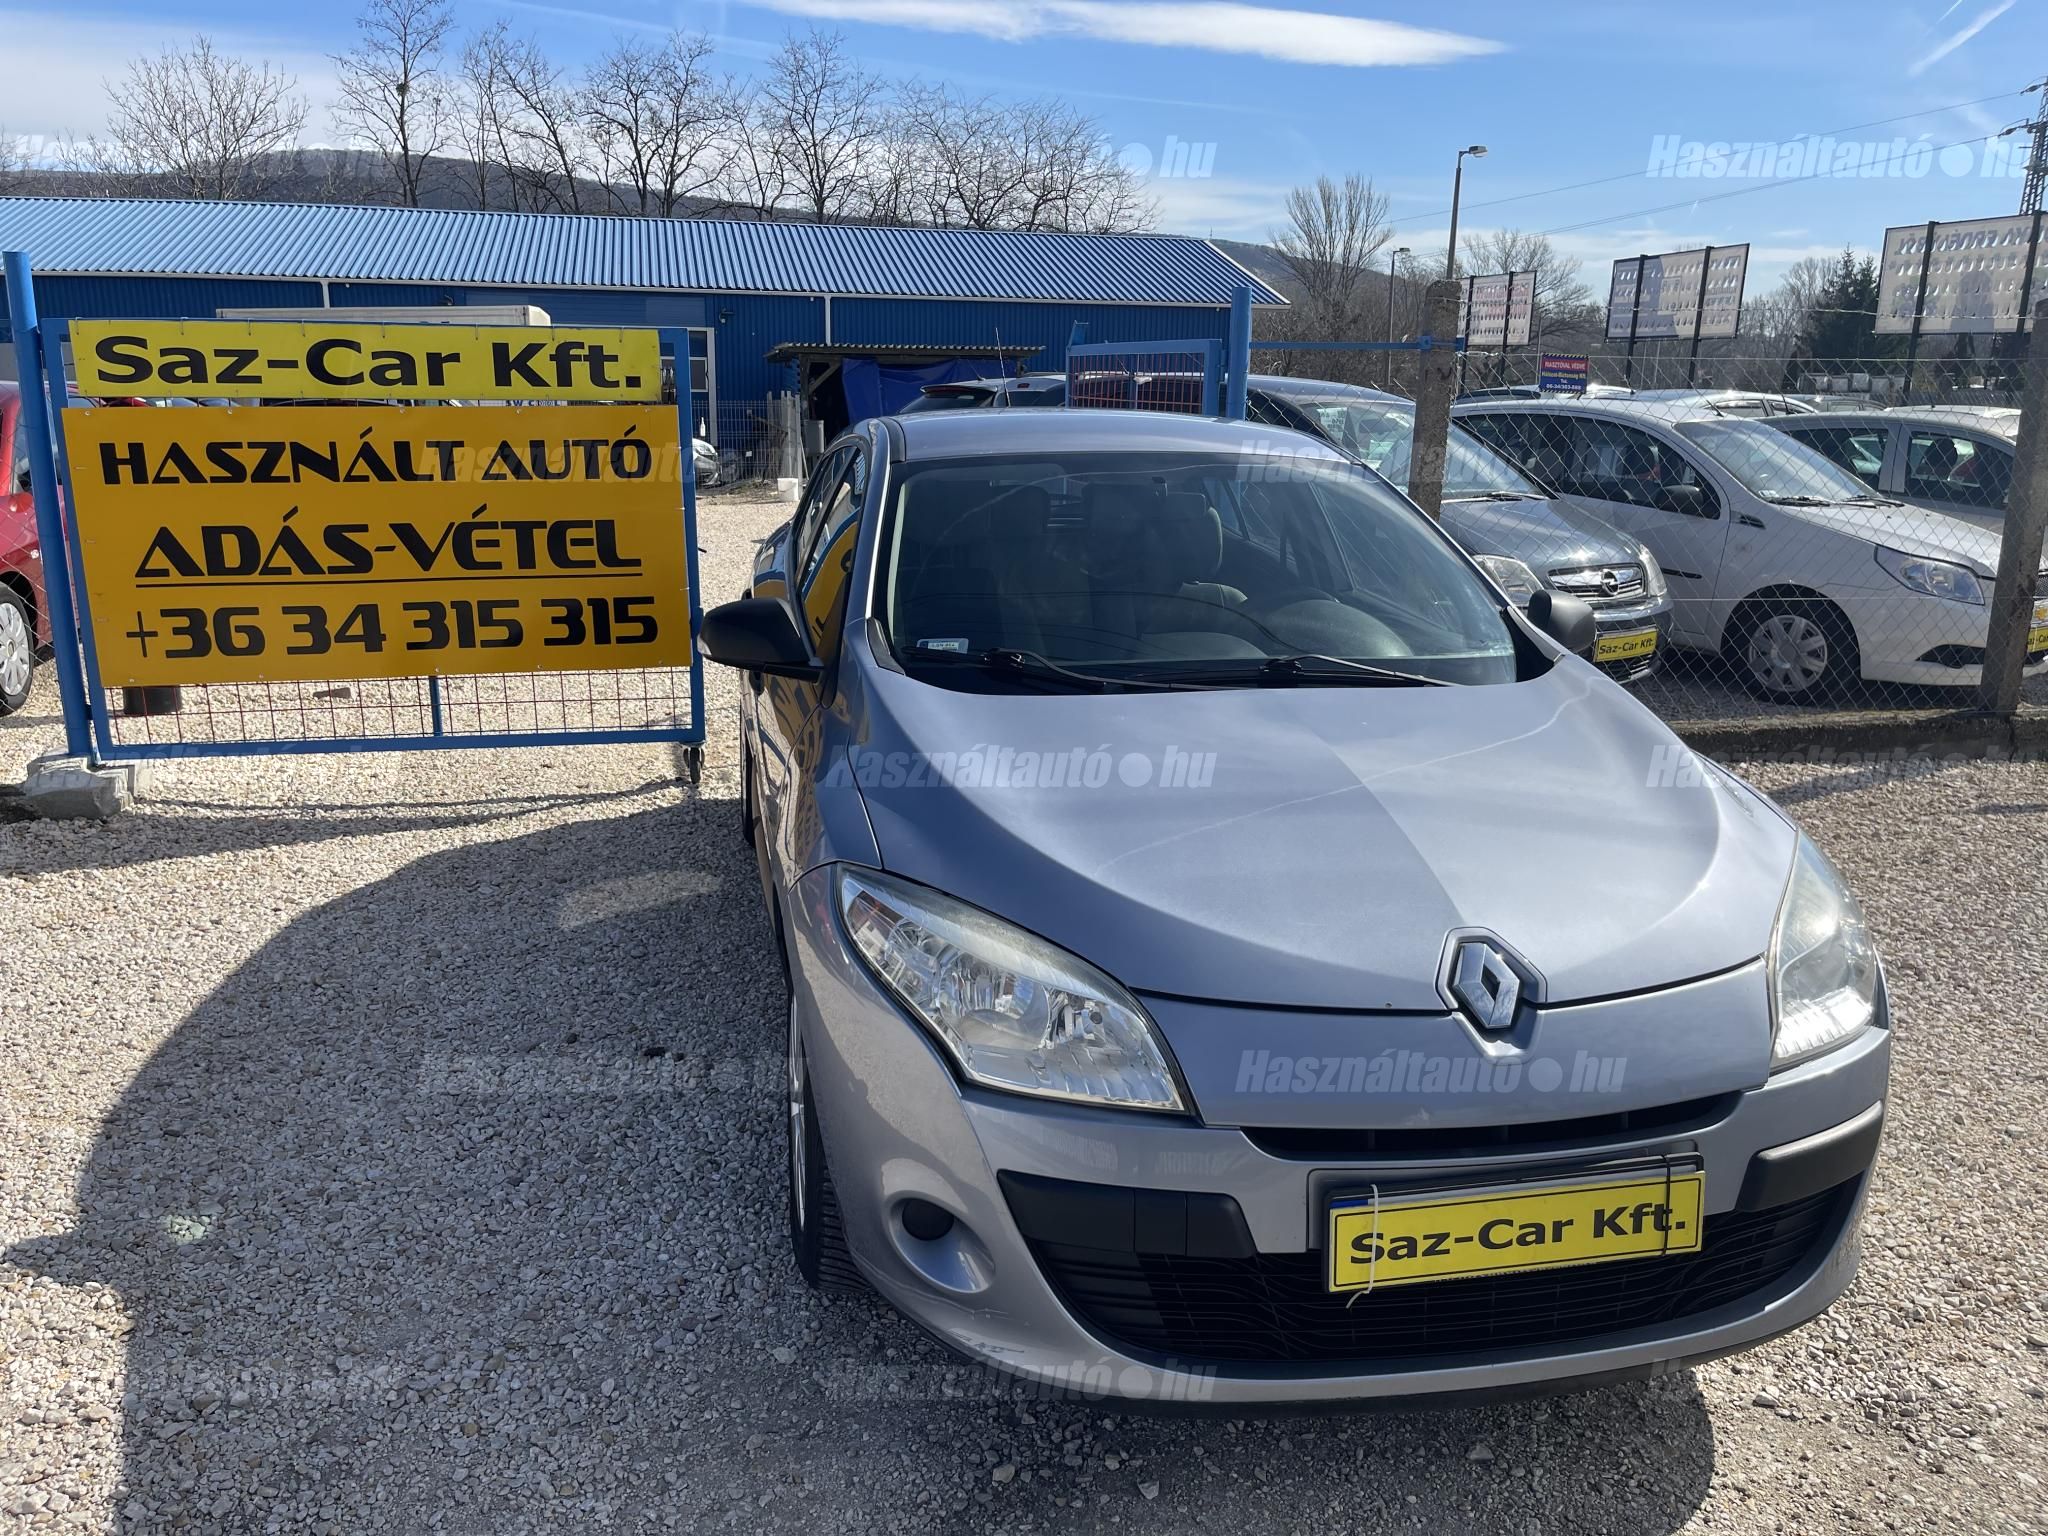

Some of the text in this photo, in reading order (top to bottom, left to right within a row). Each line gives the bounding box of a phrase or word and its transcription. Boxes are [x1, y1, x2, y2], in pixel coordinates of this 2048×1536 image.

[95, 335, 642, 389] Saz-Car Kft.
[98, 424, 652, 485] HASZNÁLT AUTÓ
[134, 503, 642, 578] ADÁS-VÉTEL
[126, 595, 659, 659] +36 34 315 315
[1599, 642, 1638, 654] Saz-Car
[1350, 1202, 1686, 1264] Saz-Car Kft.
